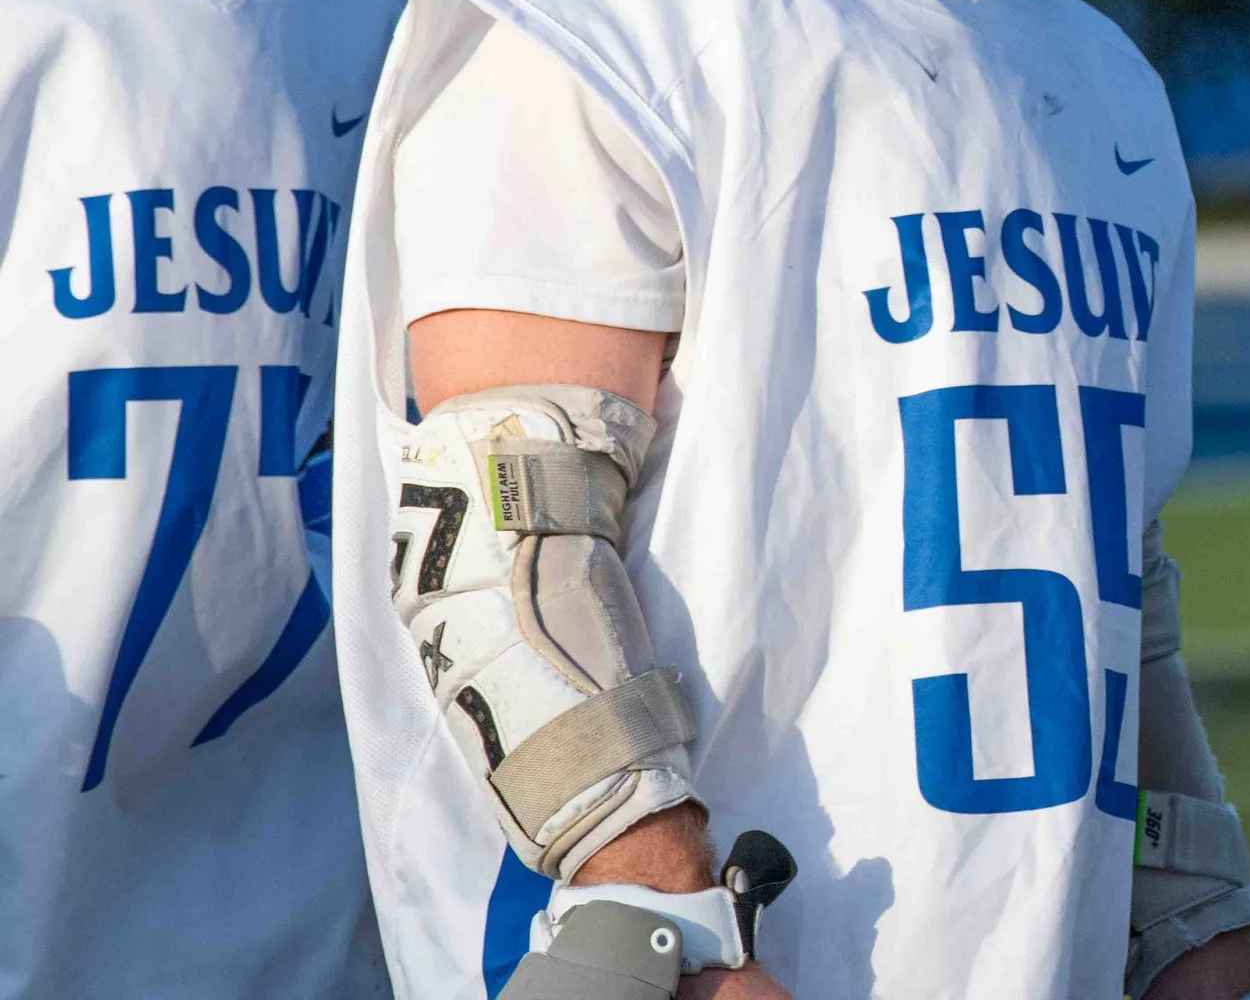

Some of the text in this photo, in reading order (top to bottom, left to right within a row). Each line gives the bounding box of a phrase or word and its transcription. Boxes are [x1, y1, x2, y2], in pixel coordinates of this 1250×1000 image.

[497, 462, 514, 521] RIGHT ARM
[510, 480, 521, 502] PULL
